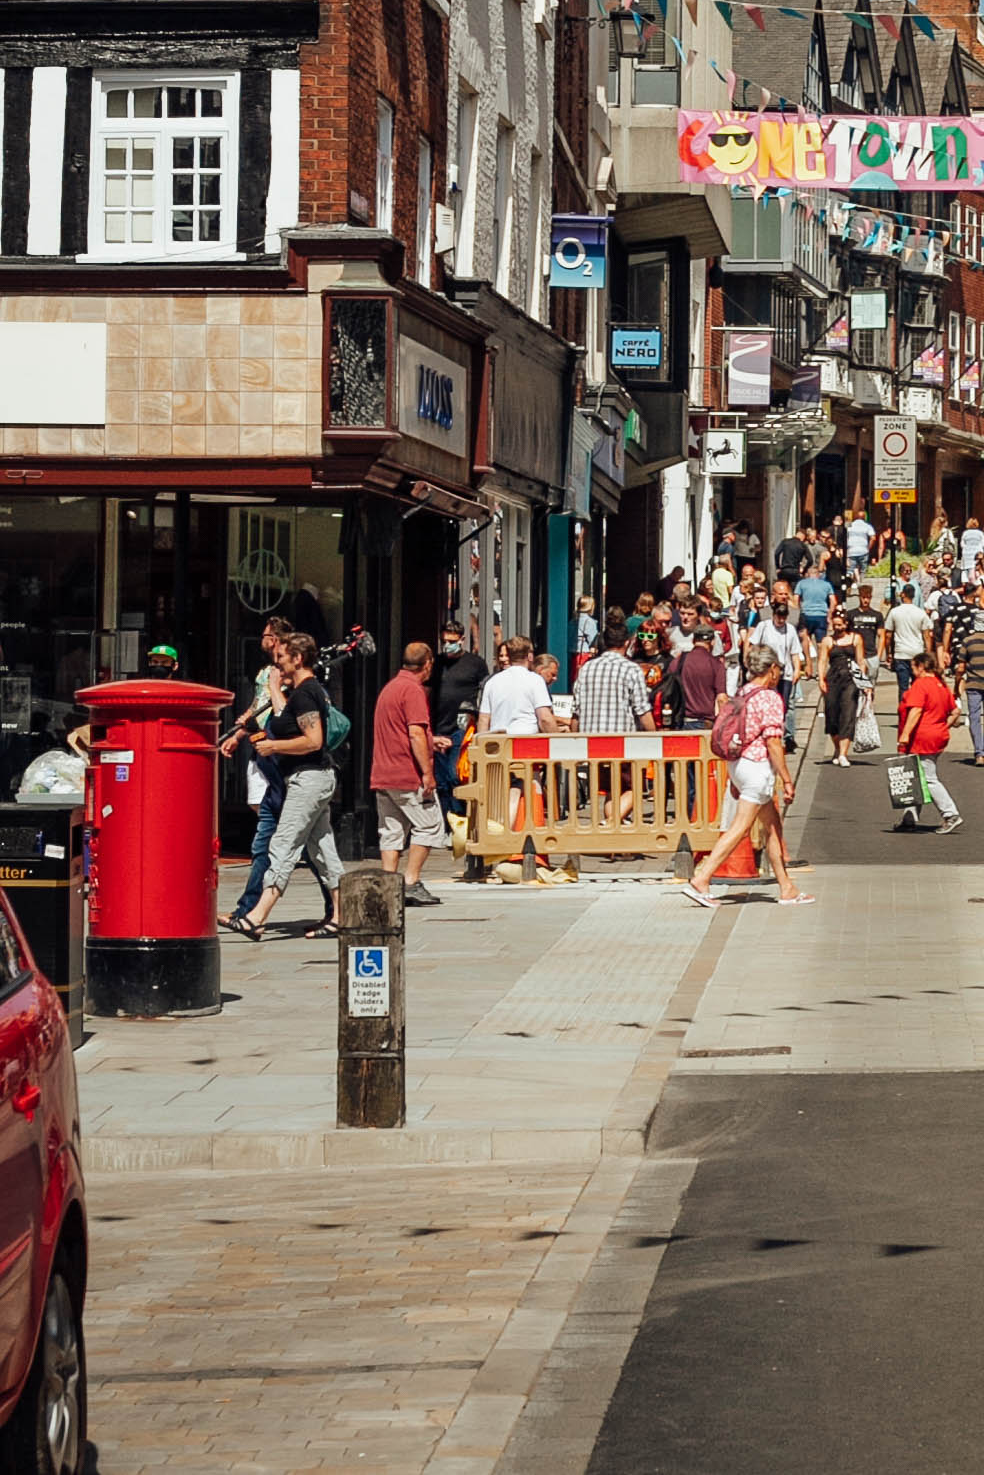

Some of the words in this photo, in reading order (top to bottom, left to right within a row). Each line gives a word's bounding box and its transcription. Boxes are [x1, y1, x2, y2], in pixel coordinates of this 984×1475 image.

[615, 348, 656, 358] NERO
[883, 422, 908, 430] ZONE
[888, 765, 905, 775] DRY
[890, 779, 912, 788] COOL
[0, 866, 27, 879] tter
[352, 981, 387, 989] Disabled
[353, 997, 384, 1005] holders
[360, 1006, 378, 1014] only
